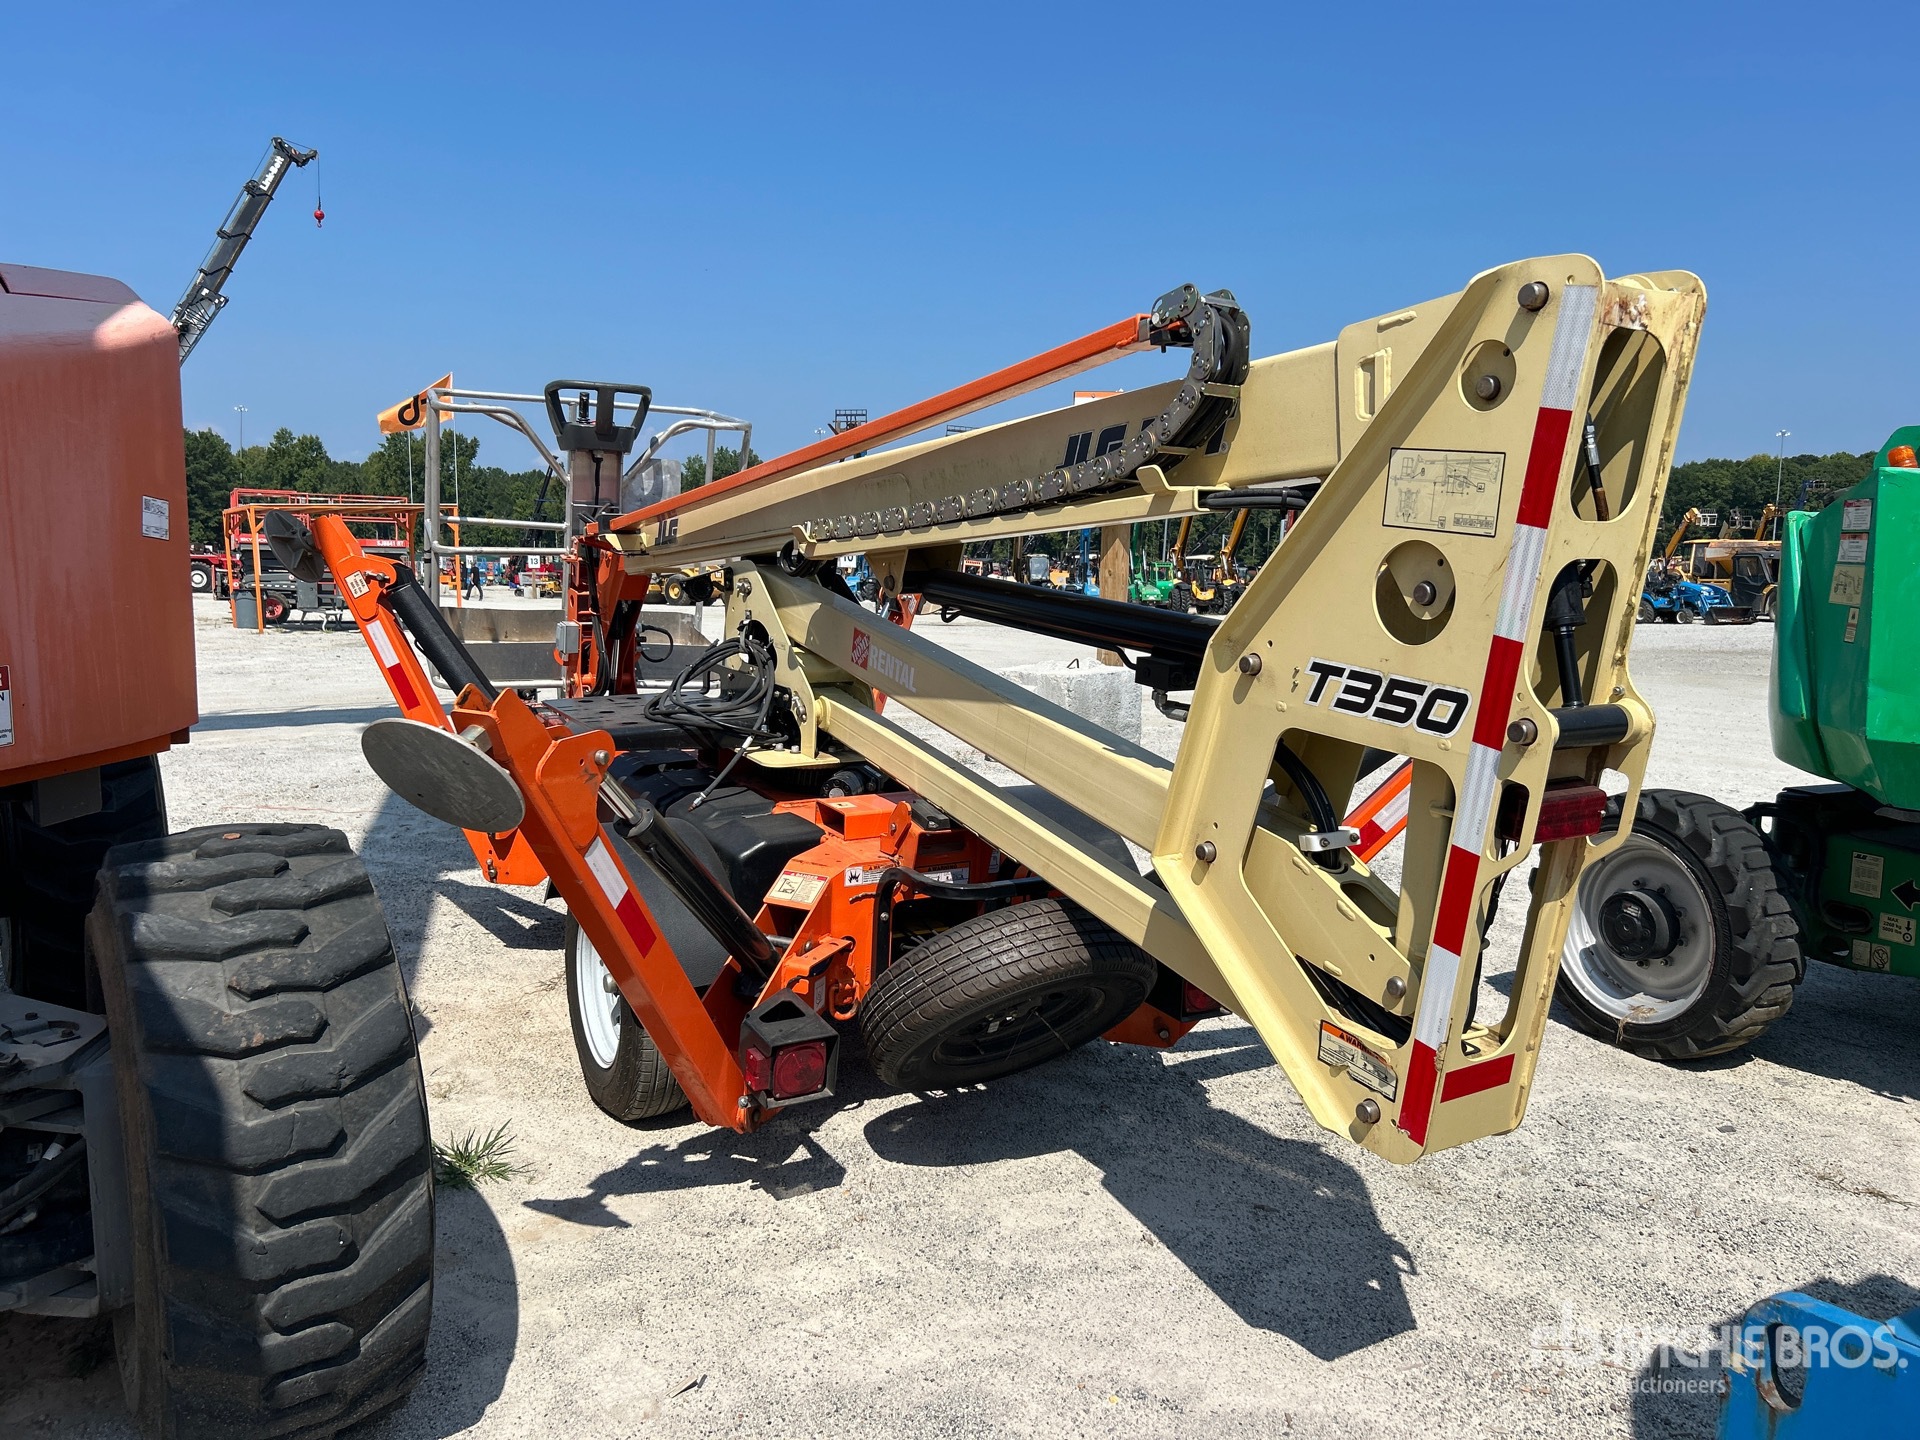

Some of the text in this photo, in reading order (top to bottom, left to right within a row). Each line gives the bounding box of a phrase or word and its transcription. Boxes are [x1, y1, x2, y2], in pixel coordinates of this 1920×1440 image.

[654, 512, 679, 546] JLG
[529, 557, 539, 565] 13
[851, 632, 870, 664] HOME
[869, 644, 916, 693] RENTAL
[1308, 660, 1470, 735] T350
